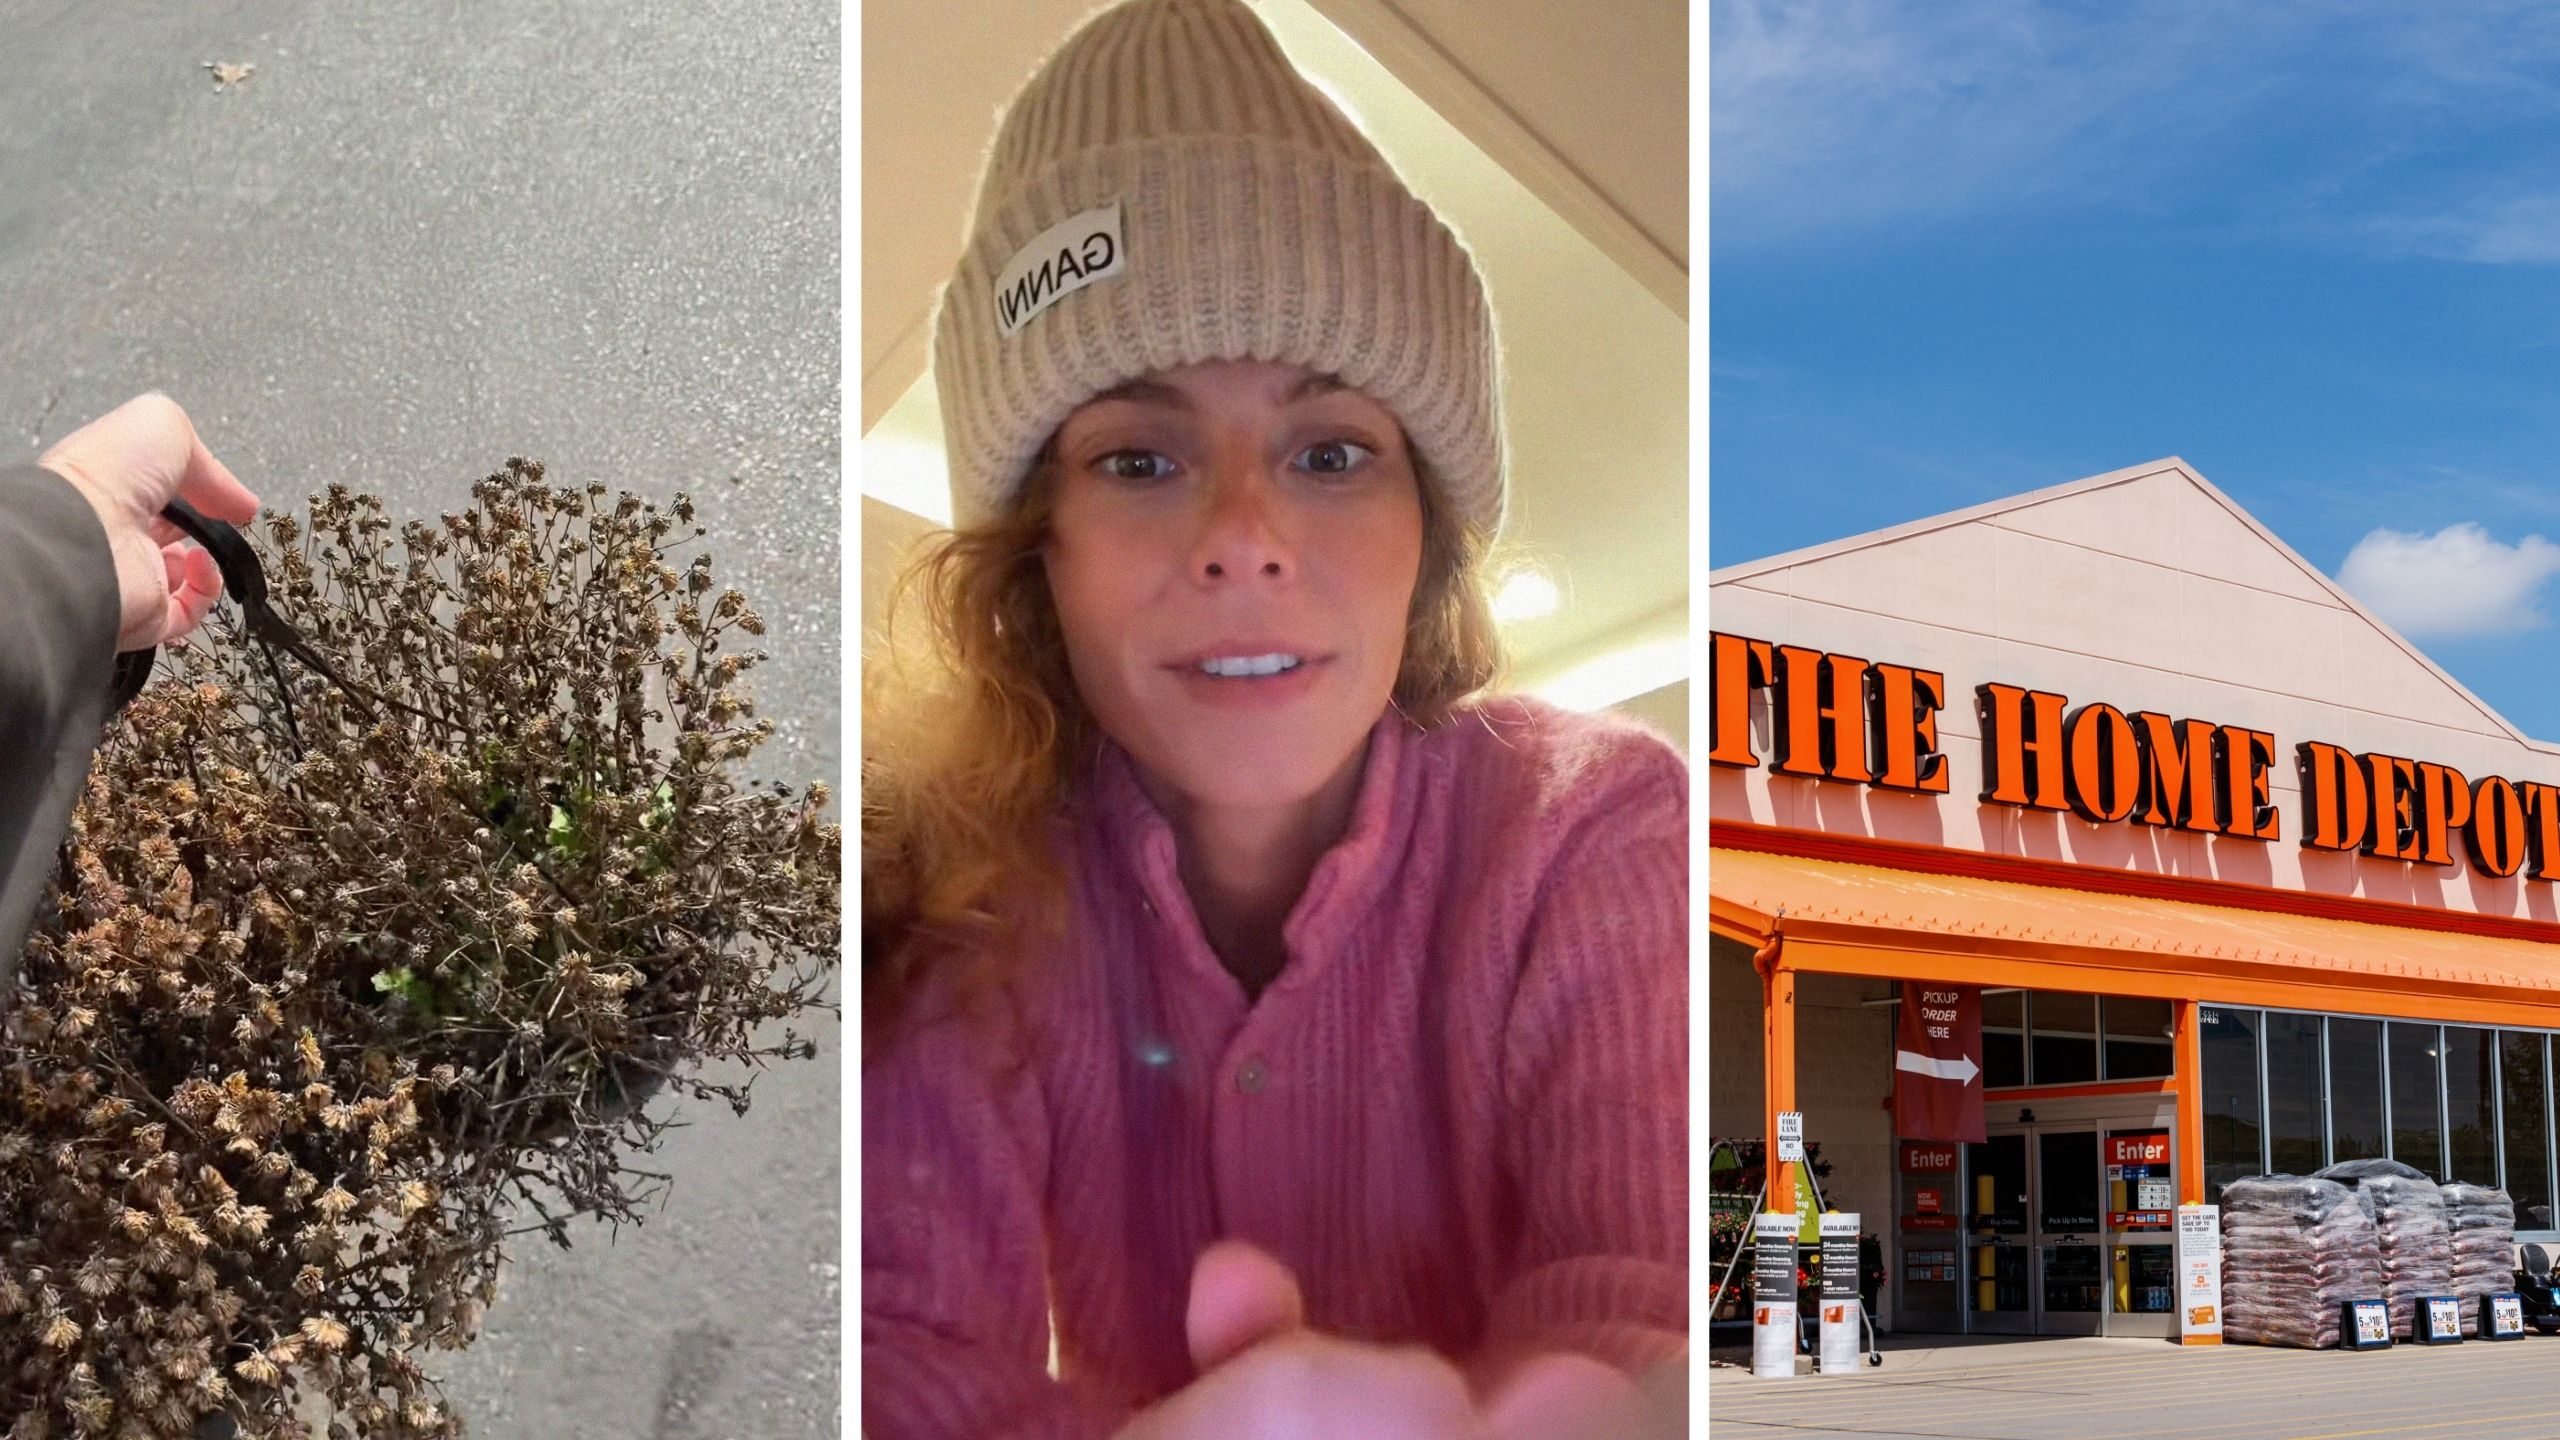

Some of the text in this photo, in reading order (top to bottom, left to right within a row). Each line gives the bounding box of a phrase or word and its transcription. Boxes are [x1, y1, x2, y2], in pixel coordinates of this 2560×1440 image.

[1709, 630, 2560, 882] THE HOME DEPOT
[1922, 991, 1959, 1004] PICKUP
[1921, 1007, 1957, 1021] ORDER
[1927, 1026, 1950, 1038] HERE
[2116, 1140, 2164, 1160] Enter
[1911, 1150, 1952, 1168] Enter
[2048, 1216, 2061, 1224] Pick
[2062, 1216, 2070, 1225] Up
[2432, 1312, 2437, 1322] 5
[2496, 1310, 2501, 1319] 5
[2359, 1316, 2364, 1327] 5
